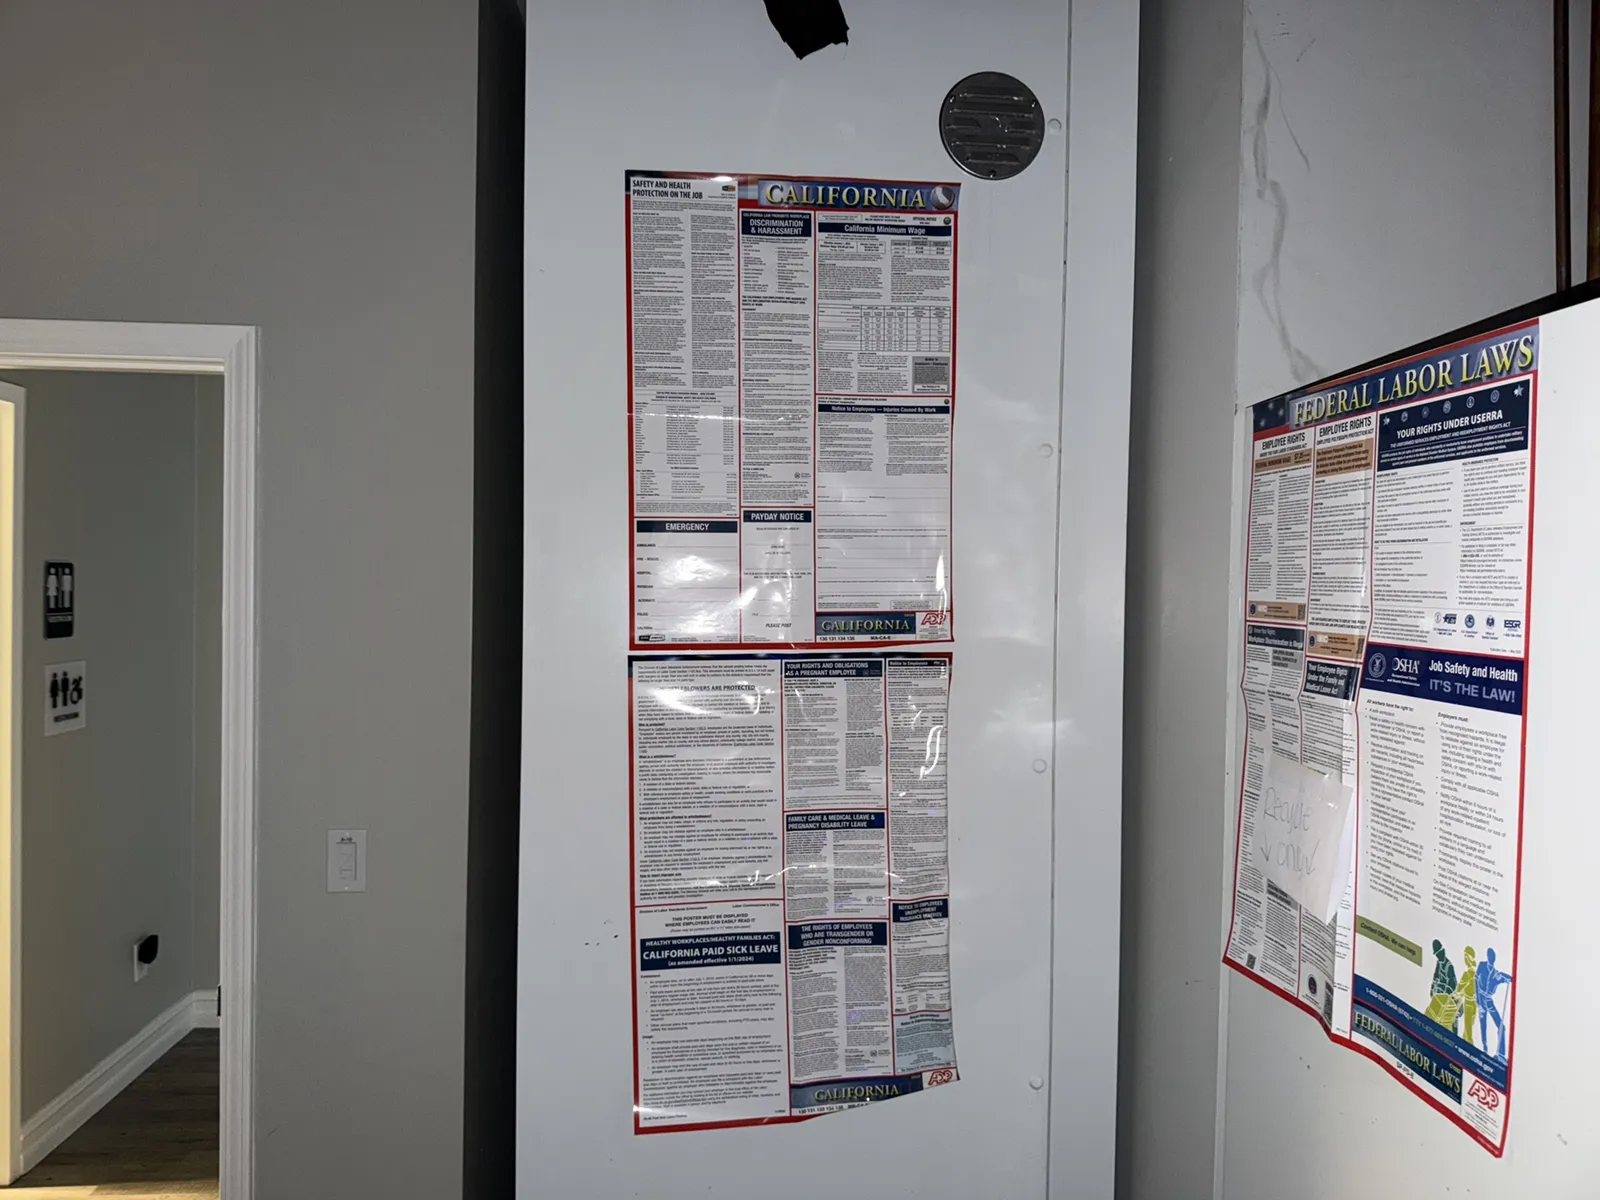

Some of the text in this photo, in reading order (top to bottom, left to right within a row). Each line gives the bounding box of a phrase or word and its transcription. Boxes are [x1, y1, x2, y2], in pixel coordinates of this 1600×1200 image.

[633, 180, 653, 188] SAFETY
[633, 189, 669, 198] PROTECTION
[670, 190, 678, 198] ON
[766, 184, 926, 208] CALIFORNIA
[750, 219, 804, 227] DISCRIMINATION
[844, 224, 926, 235] California Minimum Wage
[758, 227, 802, 235] HARASSMENT
[1294, 334, 1534, 428] FEDERAL LABOR LAWS
[1320, 416, 1371, 437] EMPLOYEE RIGHTS
[1396, 409, 1503, 439] YOUR RIGHTS UNDER USERRA
[1262, 432, 1305, 450] EMPLOYEE RIGHTS
[779, 513, 804, 521] NOTICE
[665, 523, 709, 531] EMERGENCY
[821, 613, 946, 631] CALIFORNIA ADP
[1504, 619, 1521, 629] ESGR
[1429, 659, 1518, 682] Job Safety and Health
[1429, 679, 1516, 703] IT'S THE LAW!
[788, 822, 819, 830] PREGNANCY
[672, 936, 735, 945] WORKPLACES/HEALTHY
[801, 932, 813, 940] WHO
[825, 938, 872, 946] NONCONFORMING
[643, 944, 779, 960] CALIFORNIA PAID SICK LEAVE
[1354, 1011, 1398, 1049] FEDERAL
[1400, 1039, 1430, 1074] LABOR
[1433, 1061, 1461, 1094] LAWS
[1468, 1079, 1499, 1111] ADP
[1458, 1048, 1494, 1073] www.osha.gov
[814, 1070, 953, 1101] CALIFORNIA ADP
